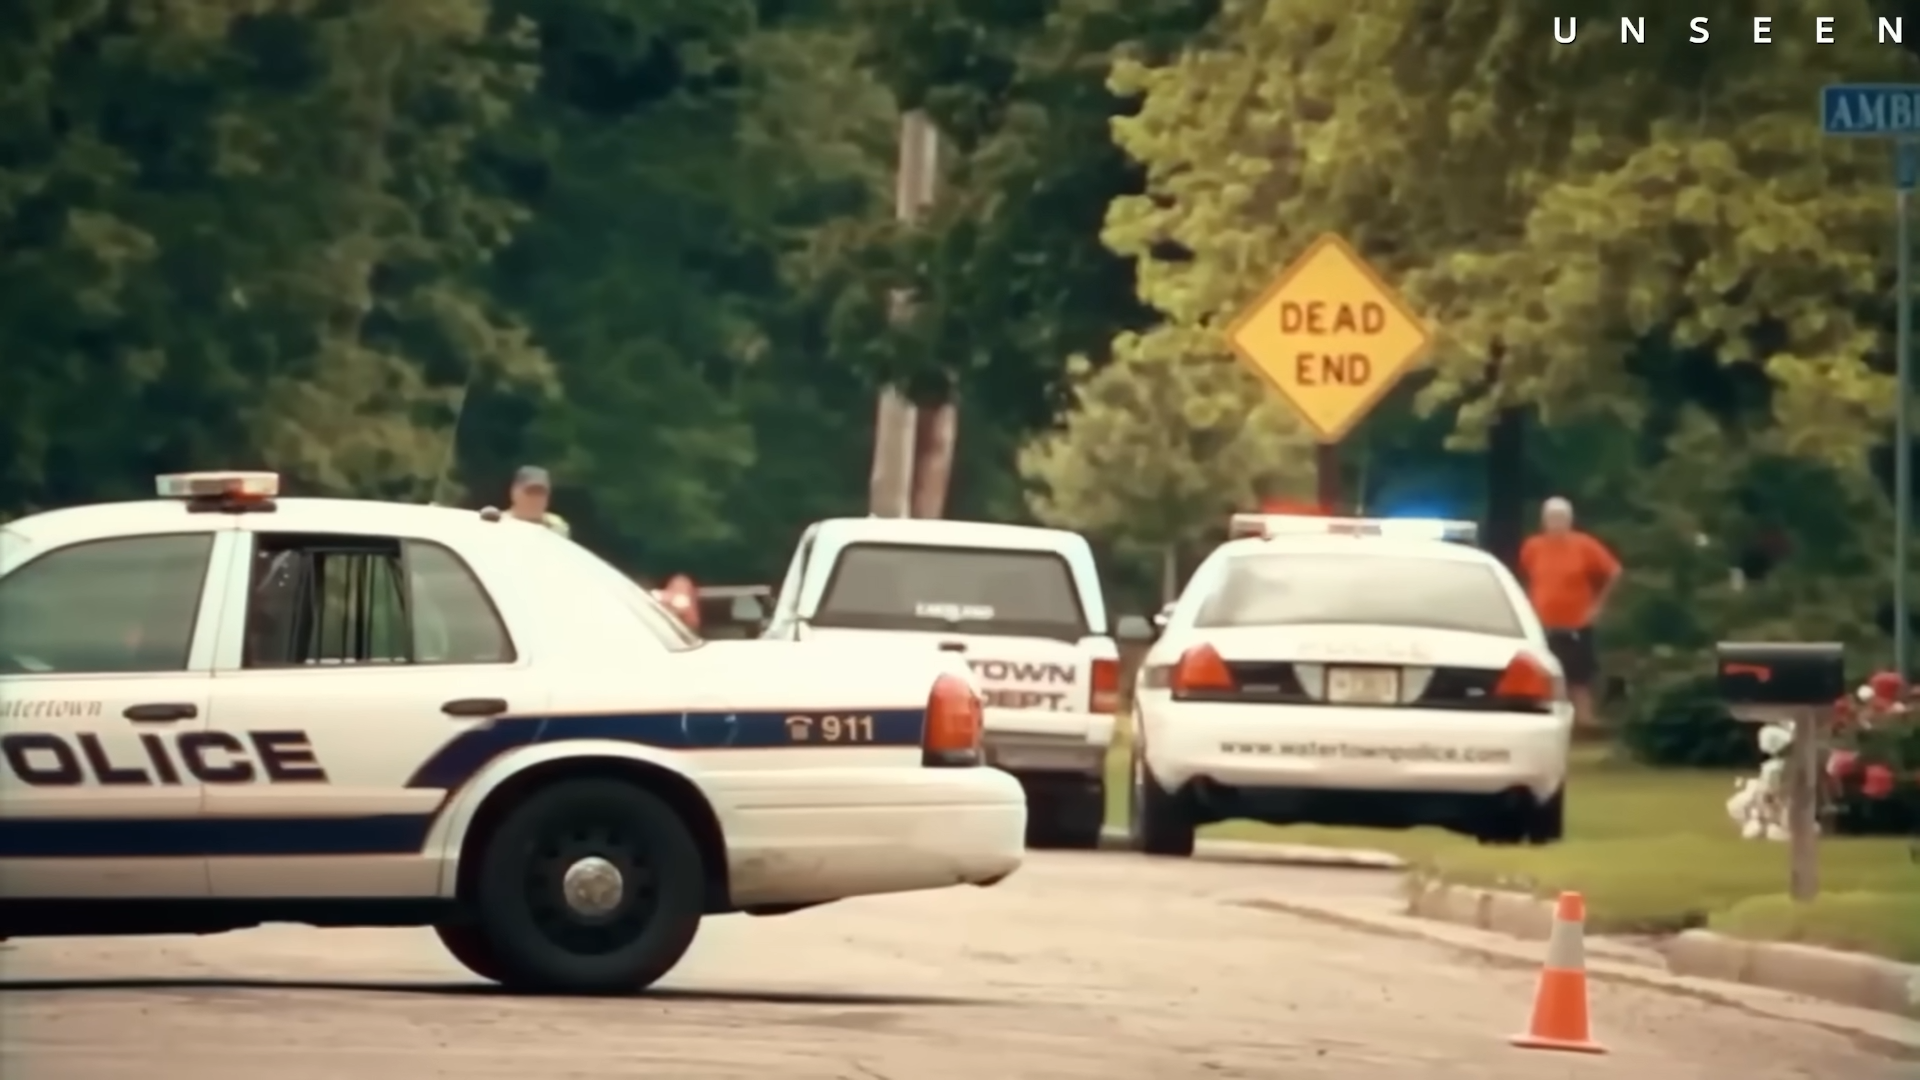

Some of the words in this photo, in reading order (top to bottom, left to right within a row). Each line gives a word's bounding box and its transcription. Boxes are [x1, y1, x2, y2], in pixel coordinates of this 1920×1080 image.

[1830, 93, 1920, 129] AMB
[1280, 301, 1385, 335] DEAD
[1295, 353, 1371, 386] END
[822, 715, 873, 741] 911
[1, 730, 330, 787] OLICE
